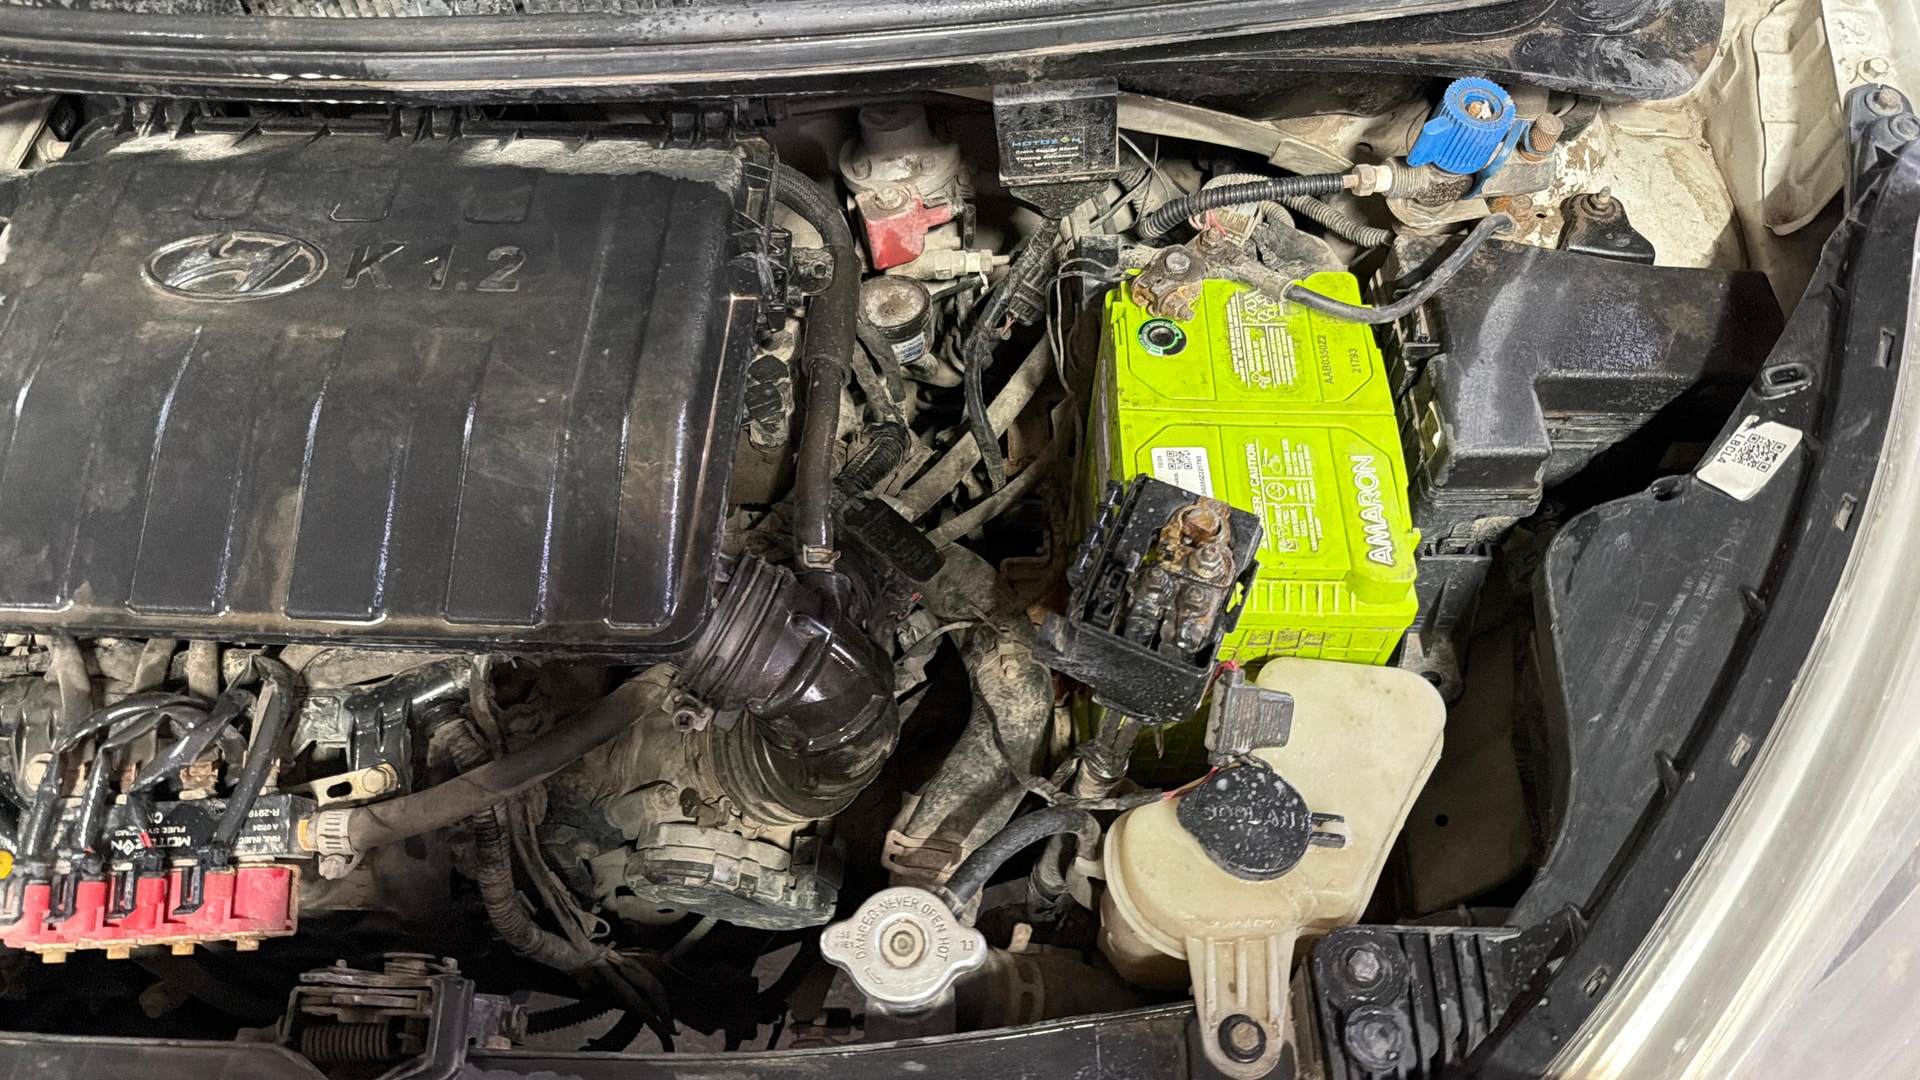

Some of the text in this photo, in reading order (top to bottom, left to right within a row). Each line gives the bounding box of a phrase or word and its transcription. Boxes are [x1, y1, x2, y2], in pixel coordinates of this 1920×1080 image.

[1347, 347, 1363, 374] 21793
[1245, 443, 1260, 487] CAUTION
[1349, 454, 1396, 566] AMARON
[162, 825, 187, 834] FUEL
[238, 835, 262, 845] INJEC
[921, 903, 948, 933] OPEN
[937, 936, 950, 962] HOT
